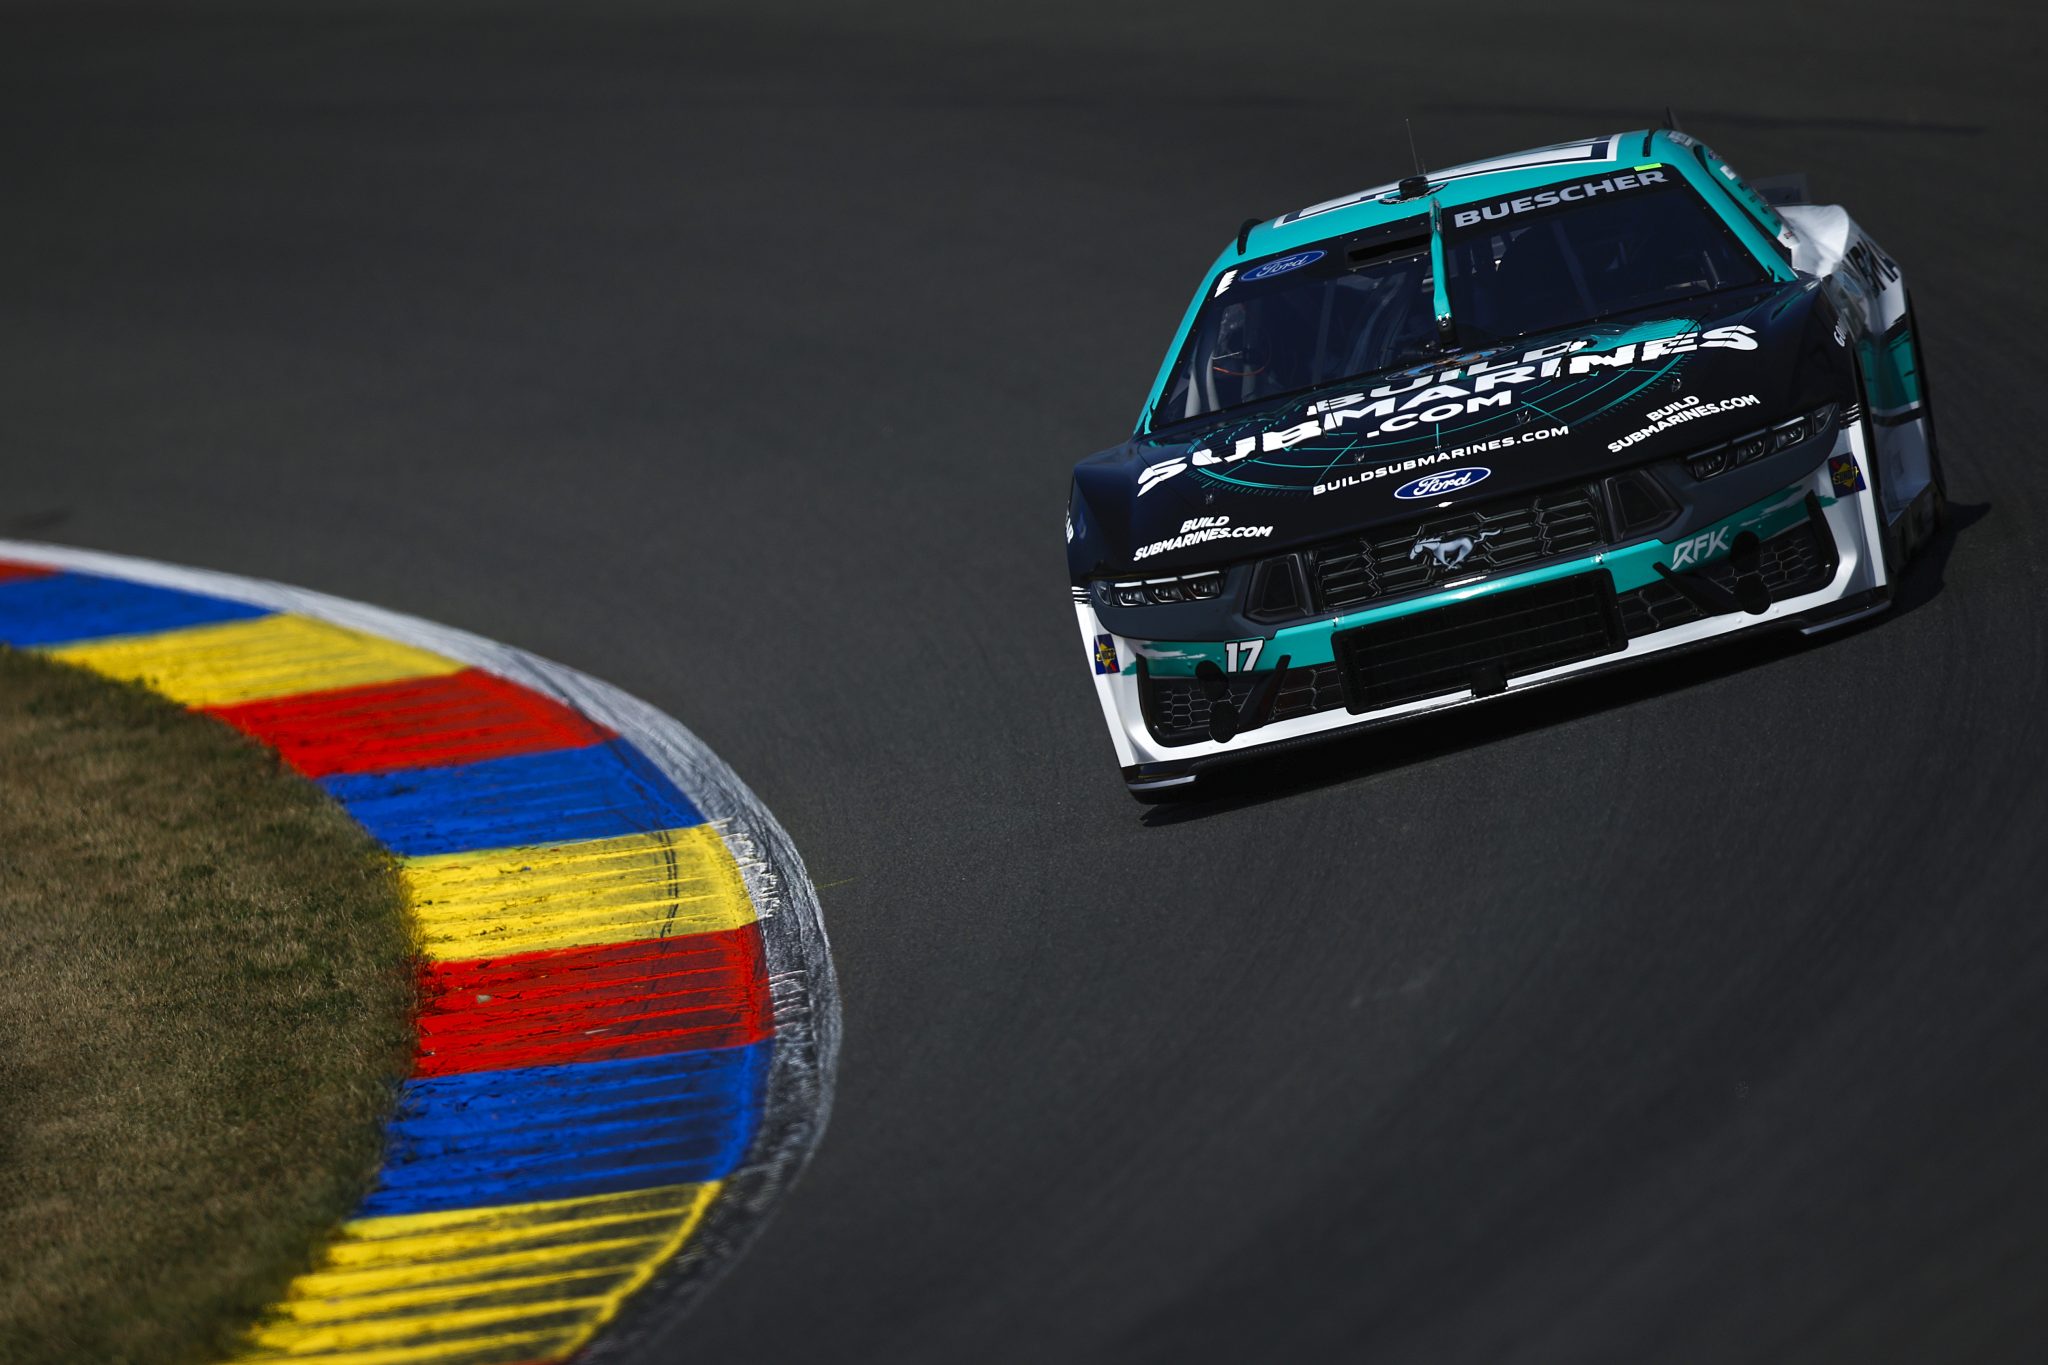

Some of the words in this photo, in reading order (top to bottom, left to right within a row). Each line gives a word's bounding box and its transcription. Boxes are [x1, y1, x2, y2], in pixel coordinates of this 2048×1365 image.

[1454, 170, 1669, 228] BUESCHER
[1256, 255, 1309, 277] Ford
[1307, 340, 1588, 416] BUILD
[1137, 325, 1759, 497] SUBMARINES
[1366, 390, 1512, 438] .COM
[1608, 394, 1760, 453] SUBMARINES.COM
[1647, 395, 1700, 422] BUILD
[1313, 425, 1569, 496] BUILDSUBMARINES.COM
[1413, 472, 1472, 495] Ford
[1133, 526, 1273, 562] SUBMARINES.COM
[1180, 516, 1230, 534] BUILD
[1670, 527, 1730, 570] RFK
[1223, 638, 1266, 674] 17
